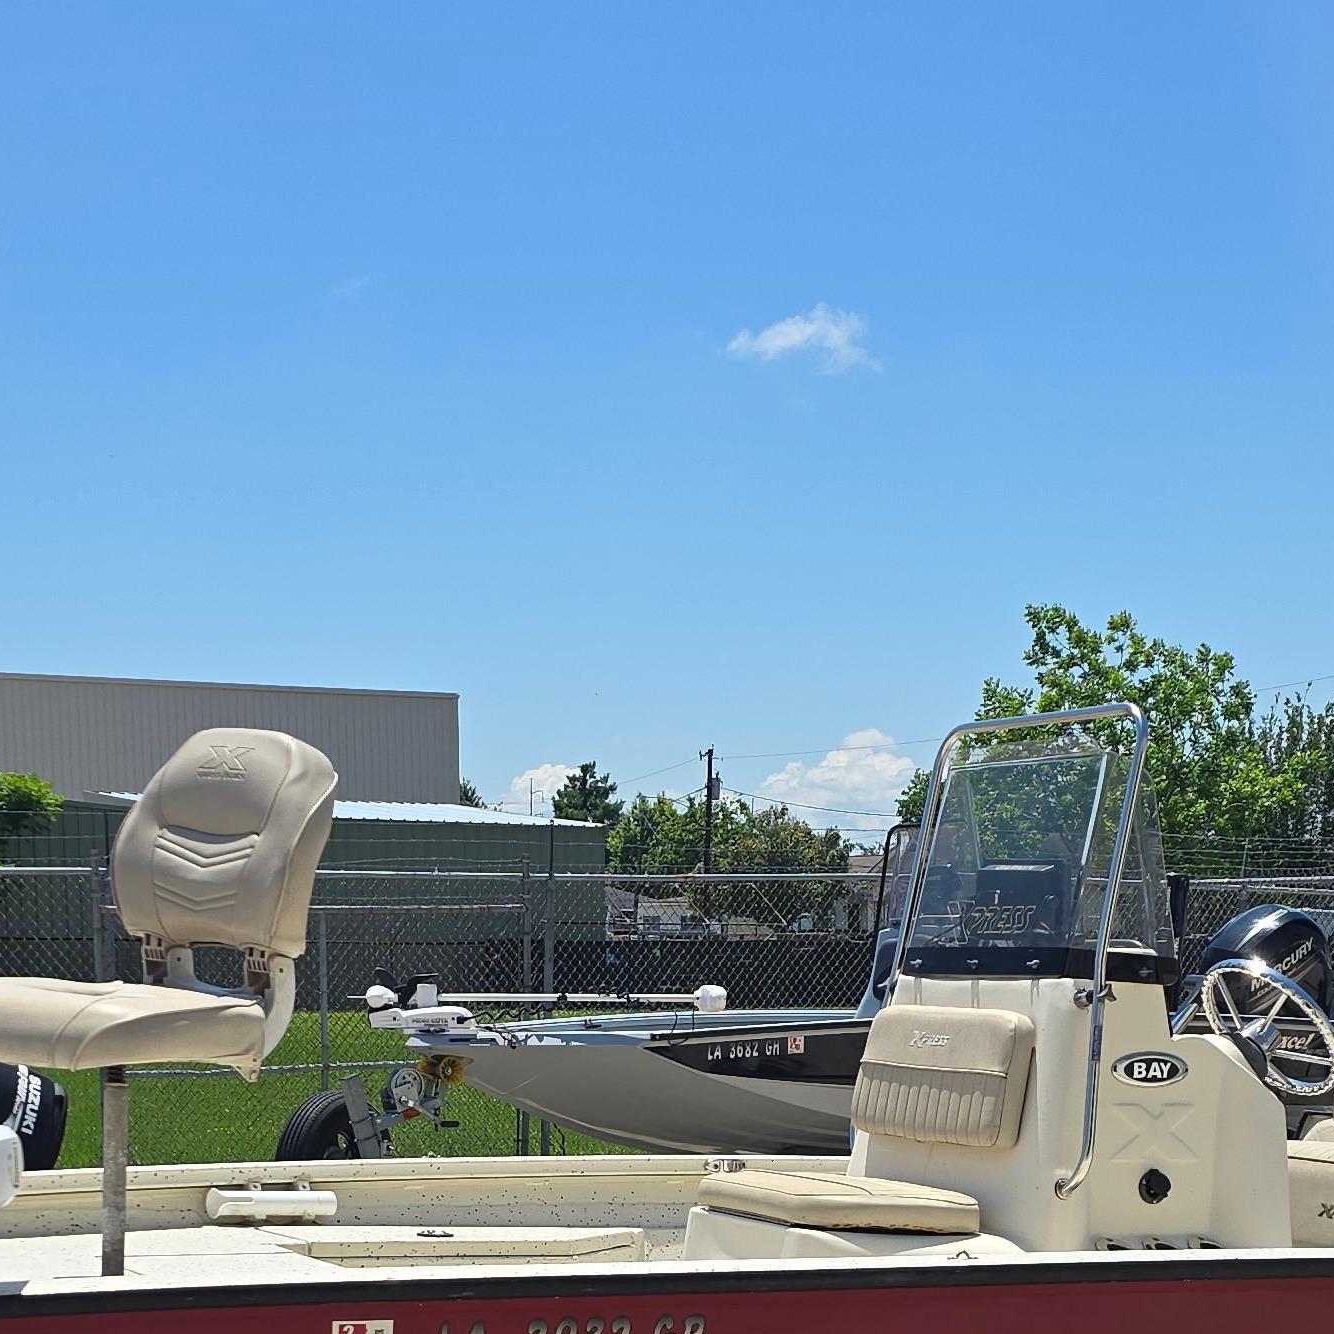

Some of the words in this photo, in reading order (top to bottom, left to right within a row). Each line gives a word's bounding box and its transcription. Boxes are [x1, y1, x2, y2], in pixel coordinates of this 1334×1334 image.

[935, 900, 1037, 945] XPRESS
[708, 1043, 722, 1060] LA
[729, 1041, 759, 1058] 3682
[1133, 1062, 1172, 1079] BAY
[21, 1074, 42, 1135] SUZUKI
